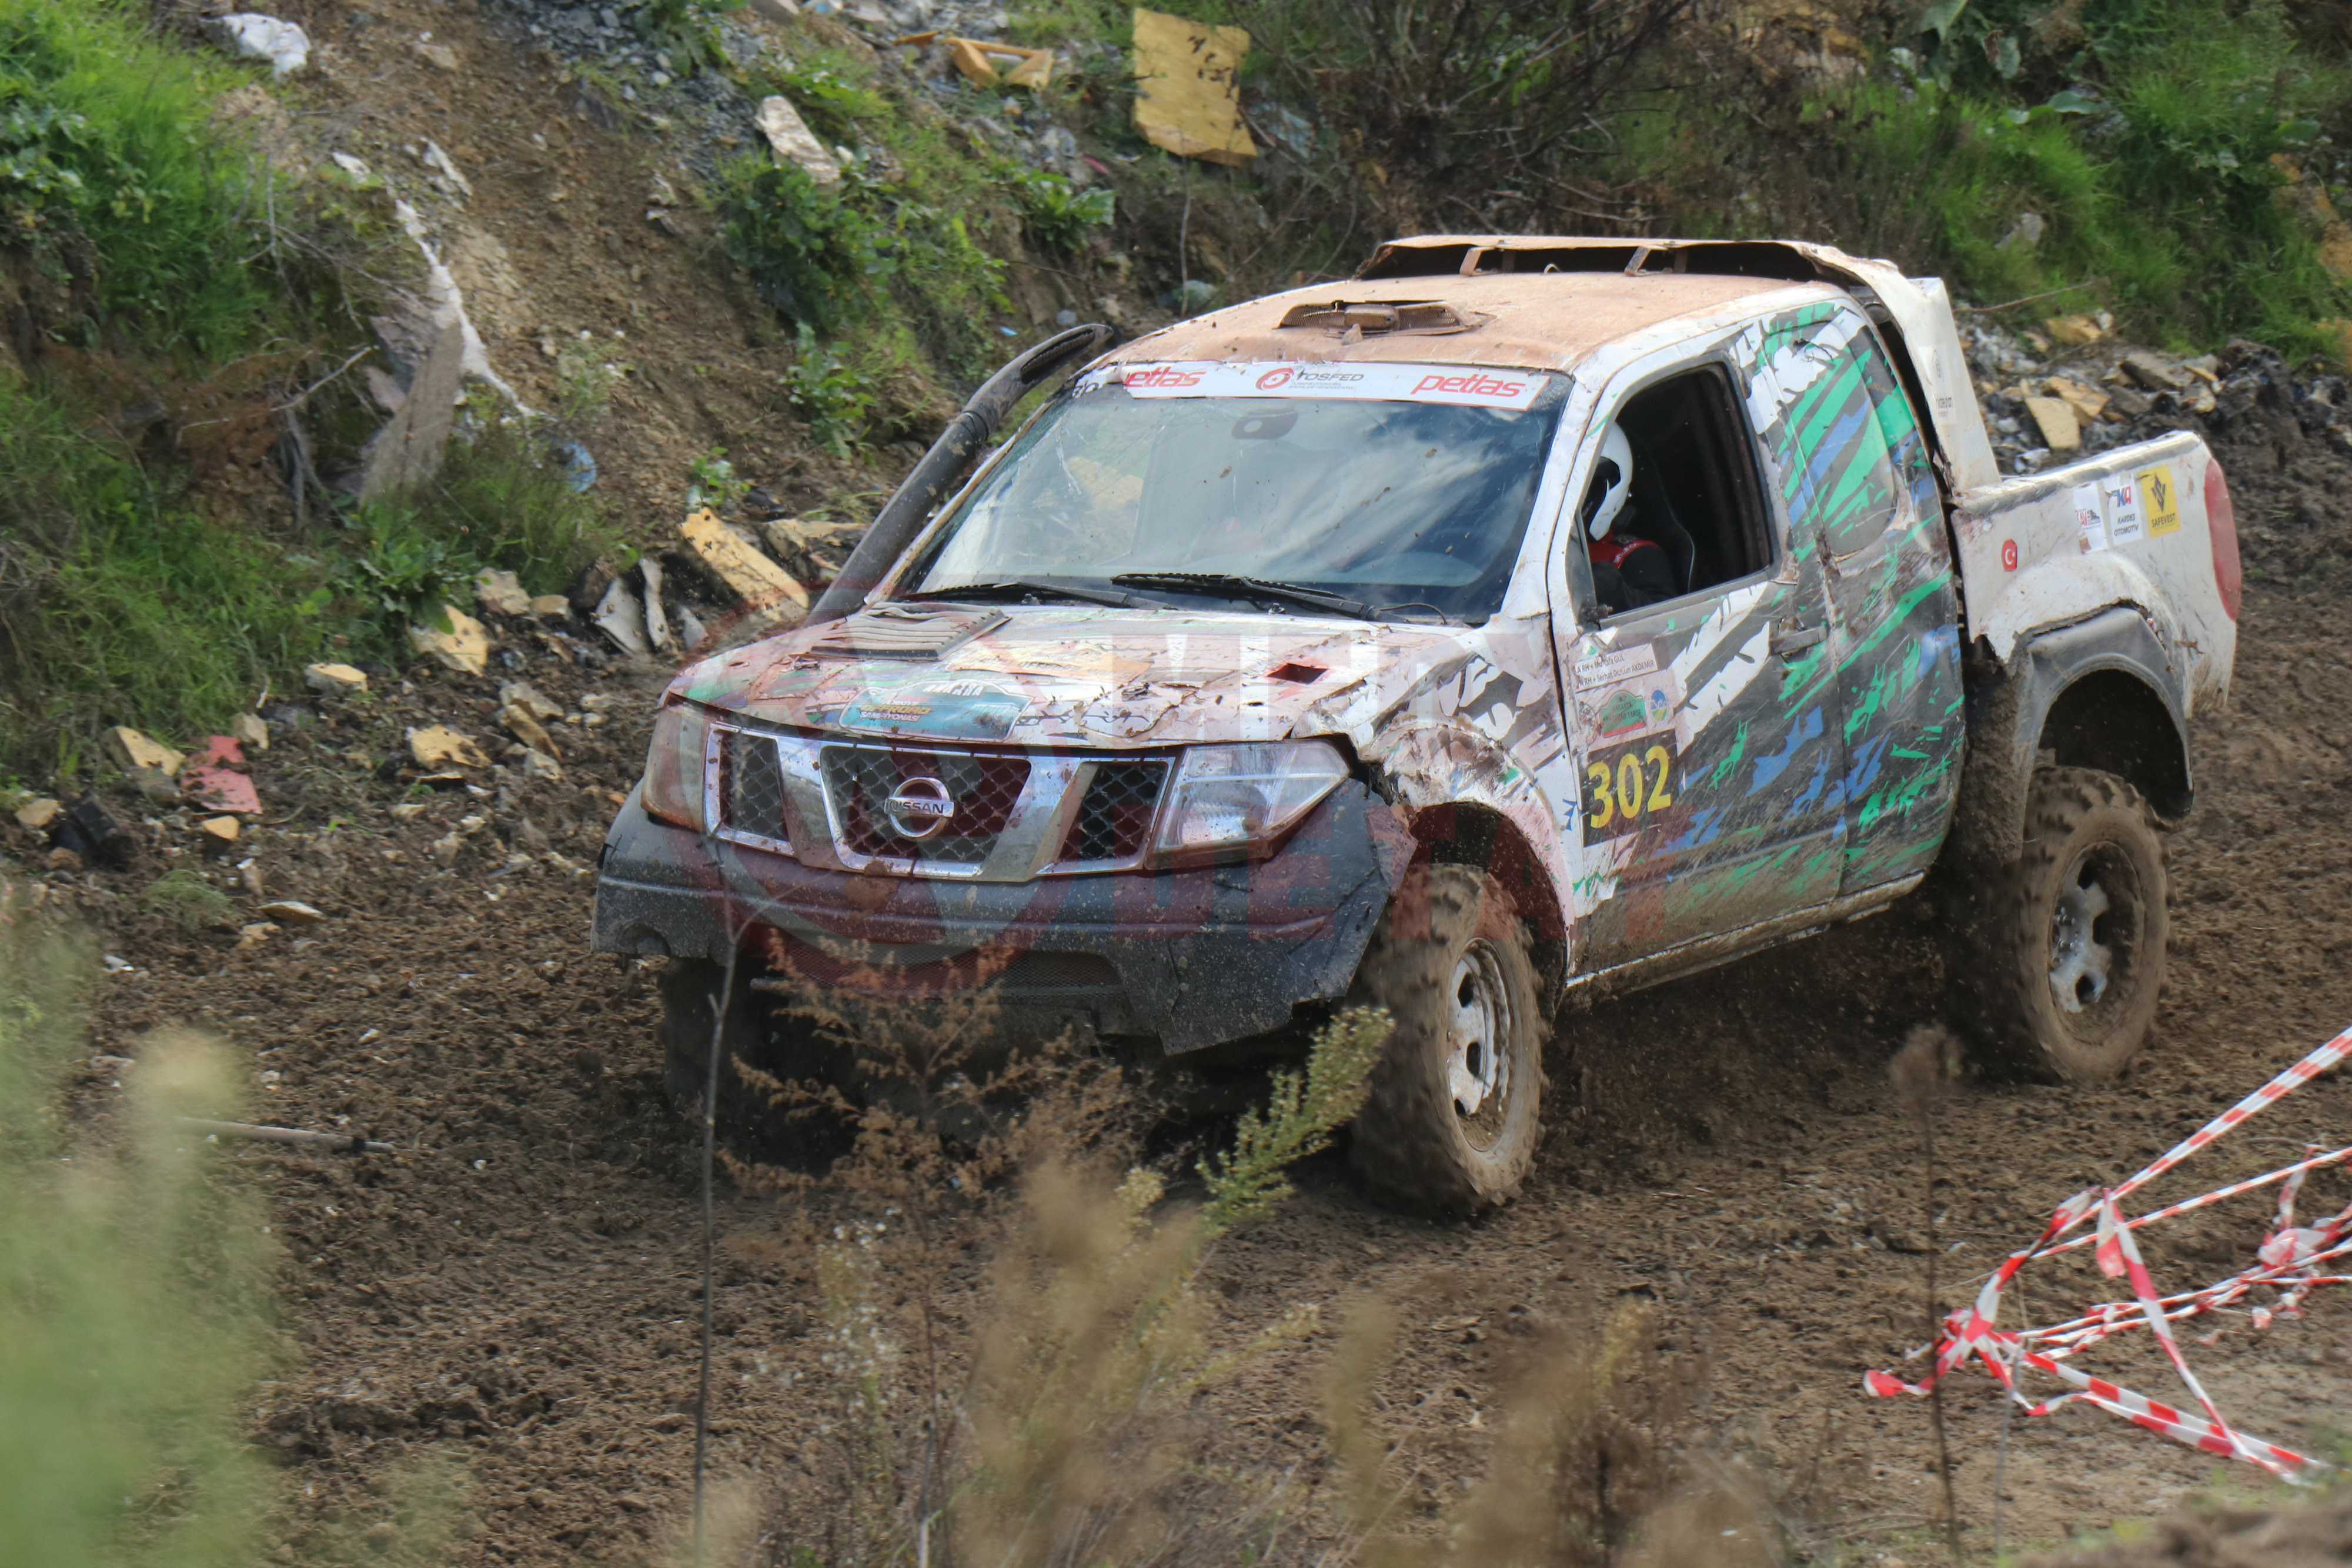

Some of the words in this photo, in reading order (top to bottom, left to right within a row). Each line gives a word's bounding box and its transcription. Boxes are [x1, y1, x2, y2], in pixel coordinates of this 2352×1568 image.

[1124, 366, 1207, 388] etlas
[1410, 374, 1528, 399] petlas
[2150, 513, 2176, 528] SAFEVEST
[1594, 657, 1613, 670] Mutafa
[1632, 658, 1655, 671] AKDEMİR
[1587, 745, 1672, 828] 302
[886, 798, 944, 814] NISSAN
